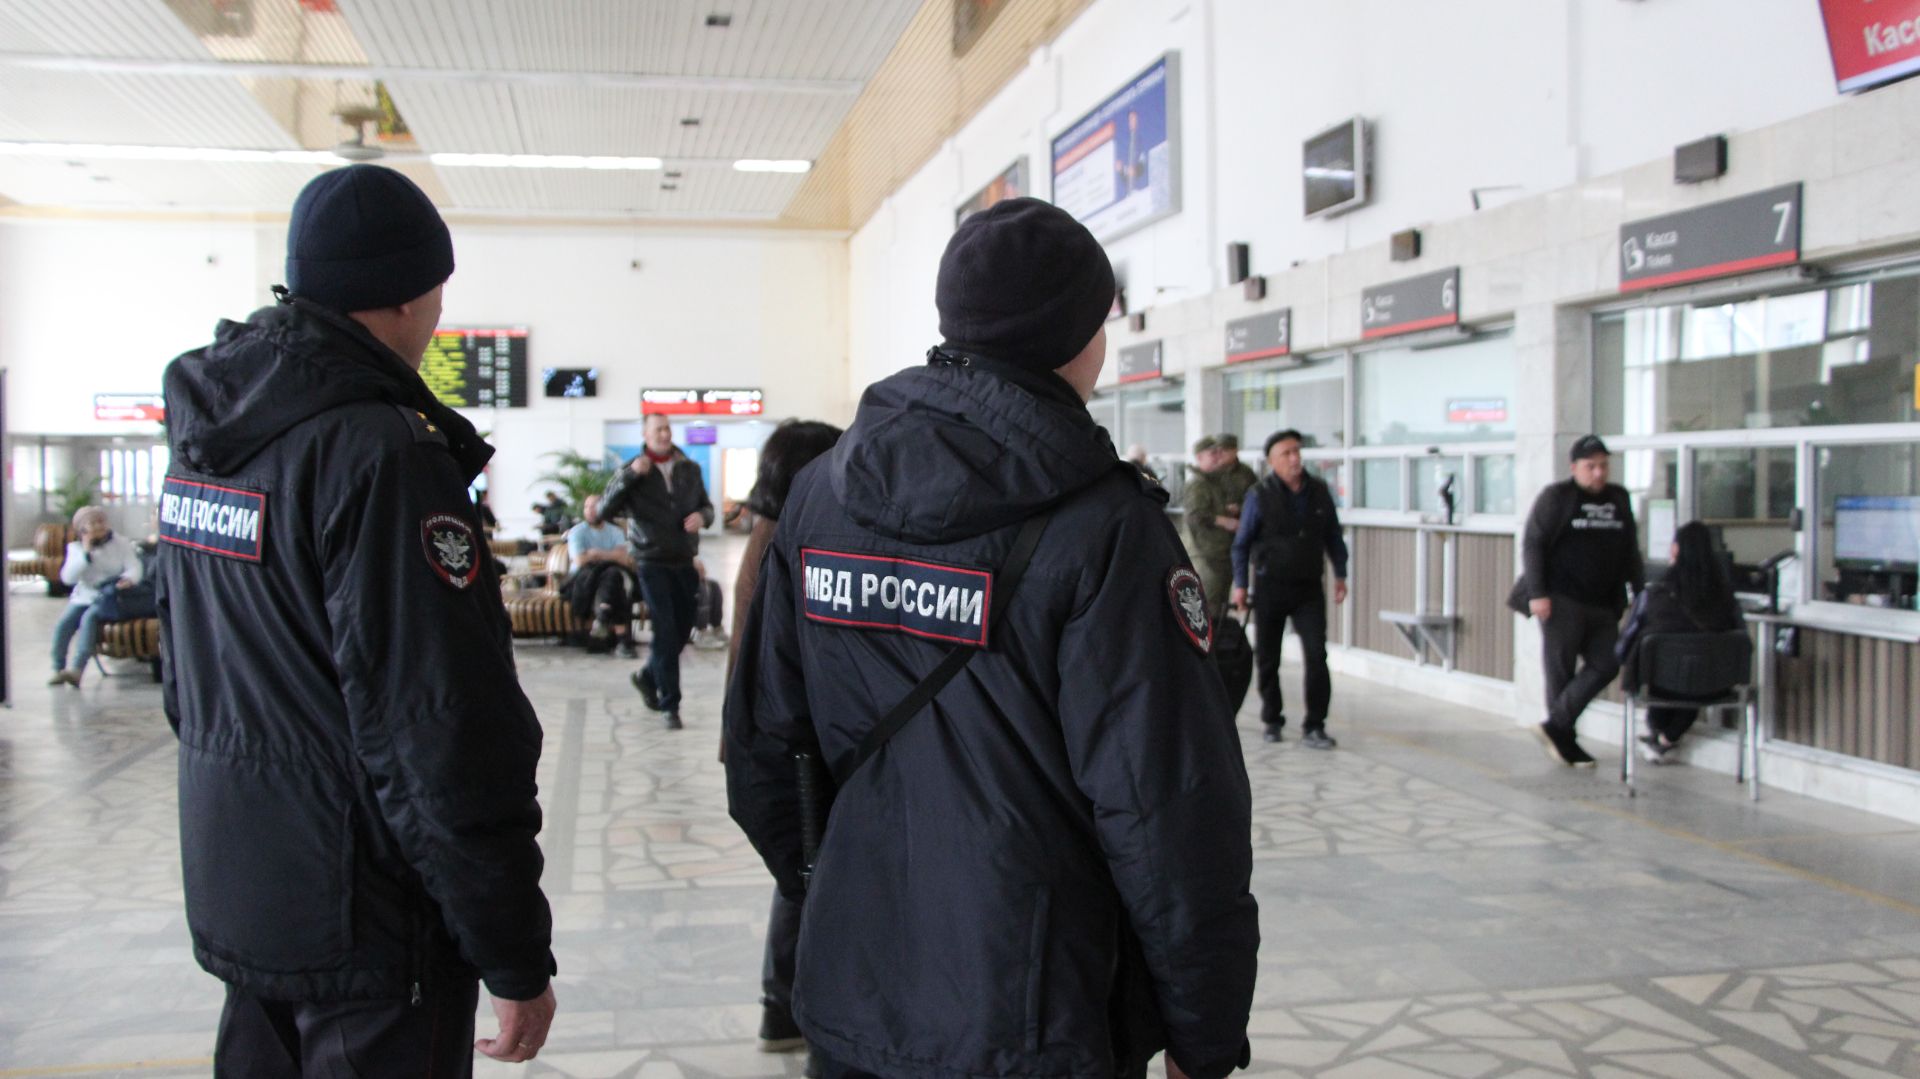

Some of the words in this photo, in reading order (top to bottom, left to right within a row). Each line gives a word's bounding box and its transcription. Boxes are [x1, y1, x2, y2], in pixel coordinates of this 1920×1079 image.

[1772, 201, 1792, 245] 7
[1442, 278, 1454, 310] 6
[1278, 317, 1287, 343] 5
[805, 566, 852, 613] МВД
[861, 573, 984, 625] РОССИИ
